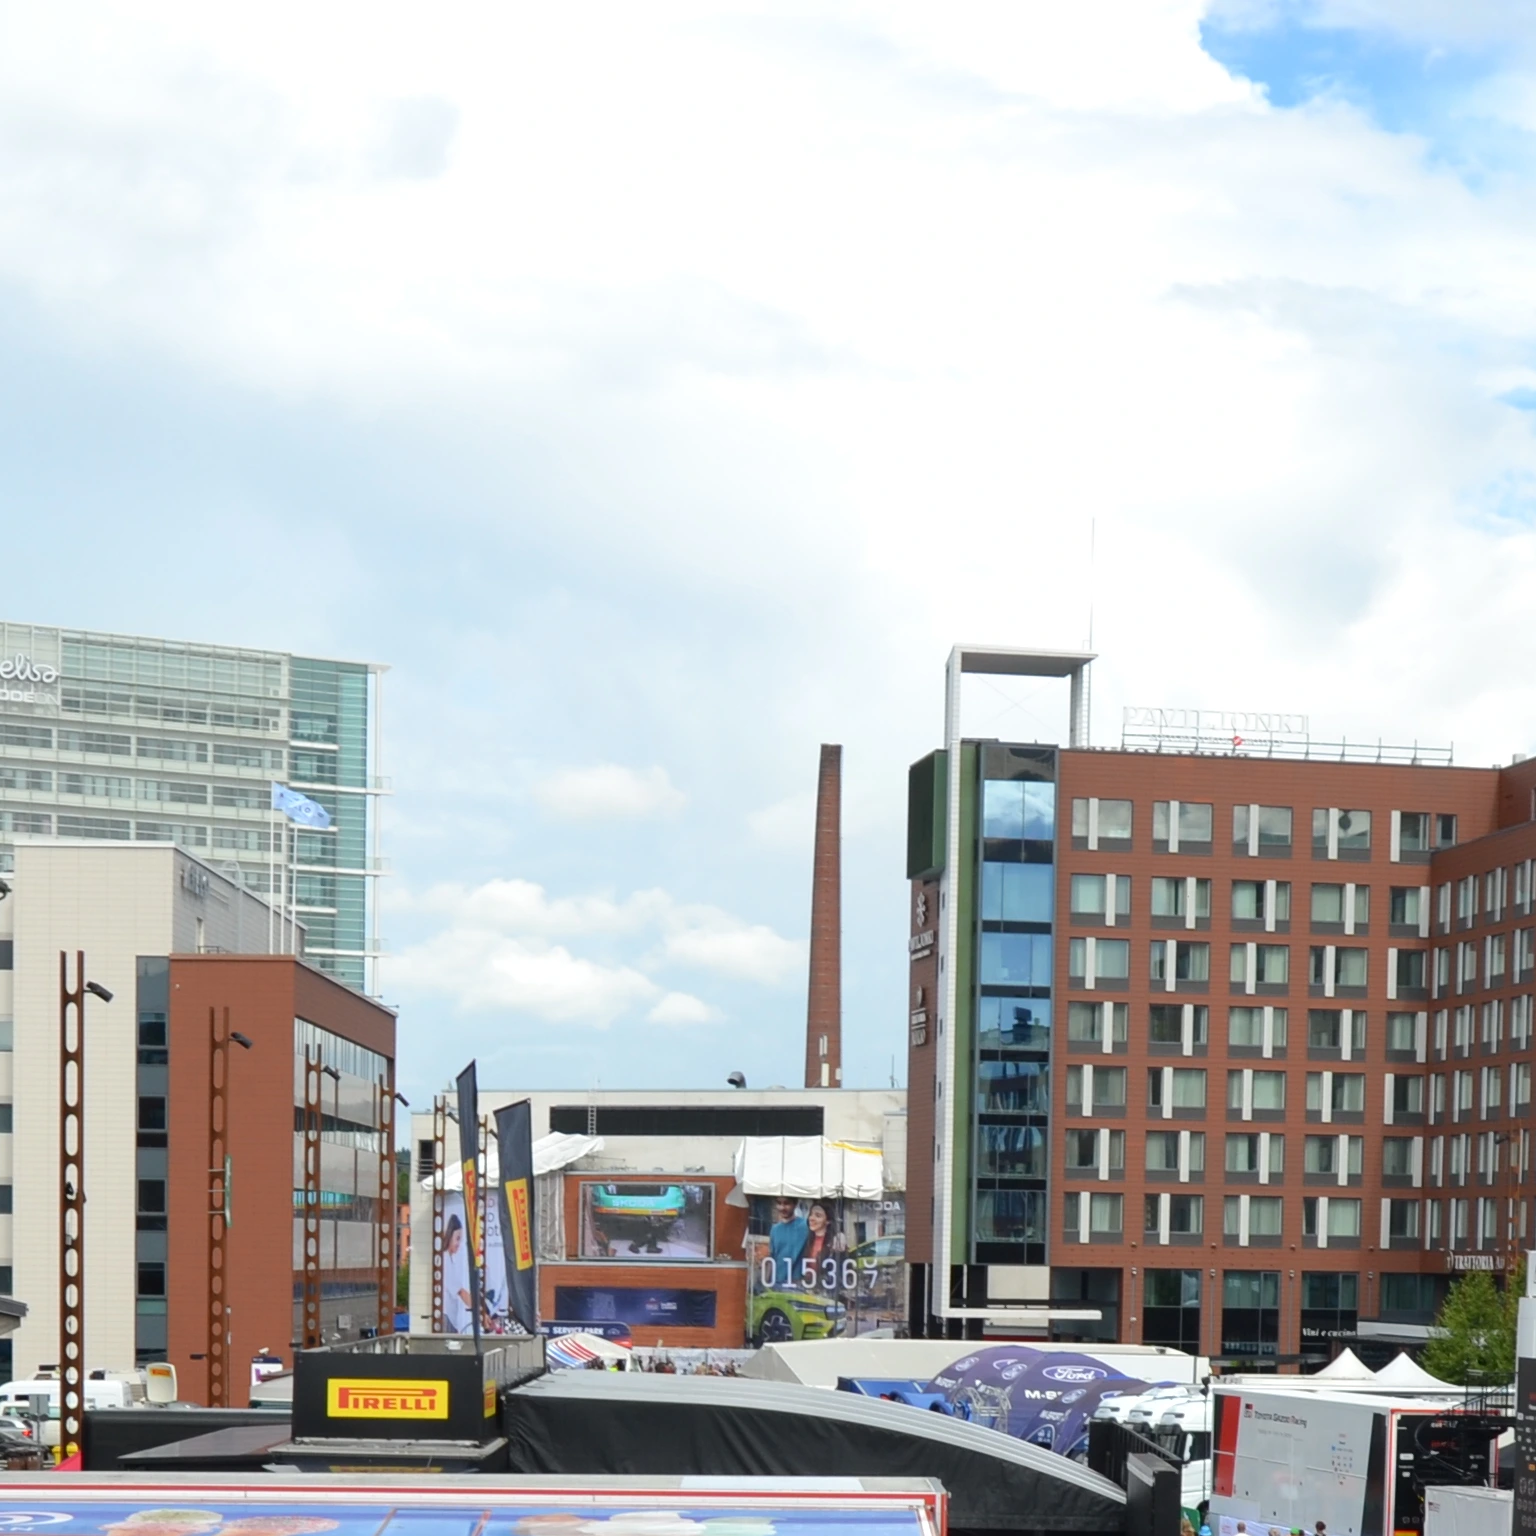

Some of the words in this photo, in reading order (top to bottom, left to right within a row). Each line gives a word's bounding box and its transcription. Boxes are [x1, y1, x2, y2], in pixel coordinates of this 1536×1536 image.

[1455, 1255, 1494, 1270] TRATTORIA
[1054, 1367, 1096, 1380] Ford
[338, 1387, 437, 1410] PIRELLI
